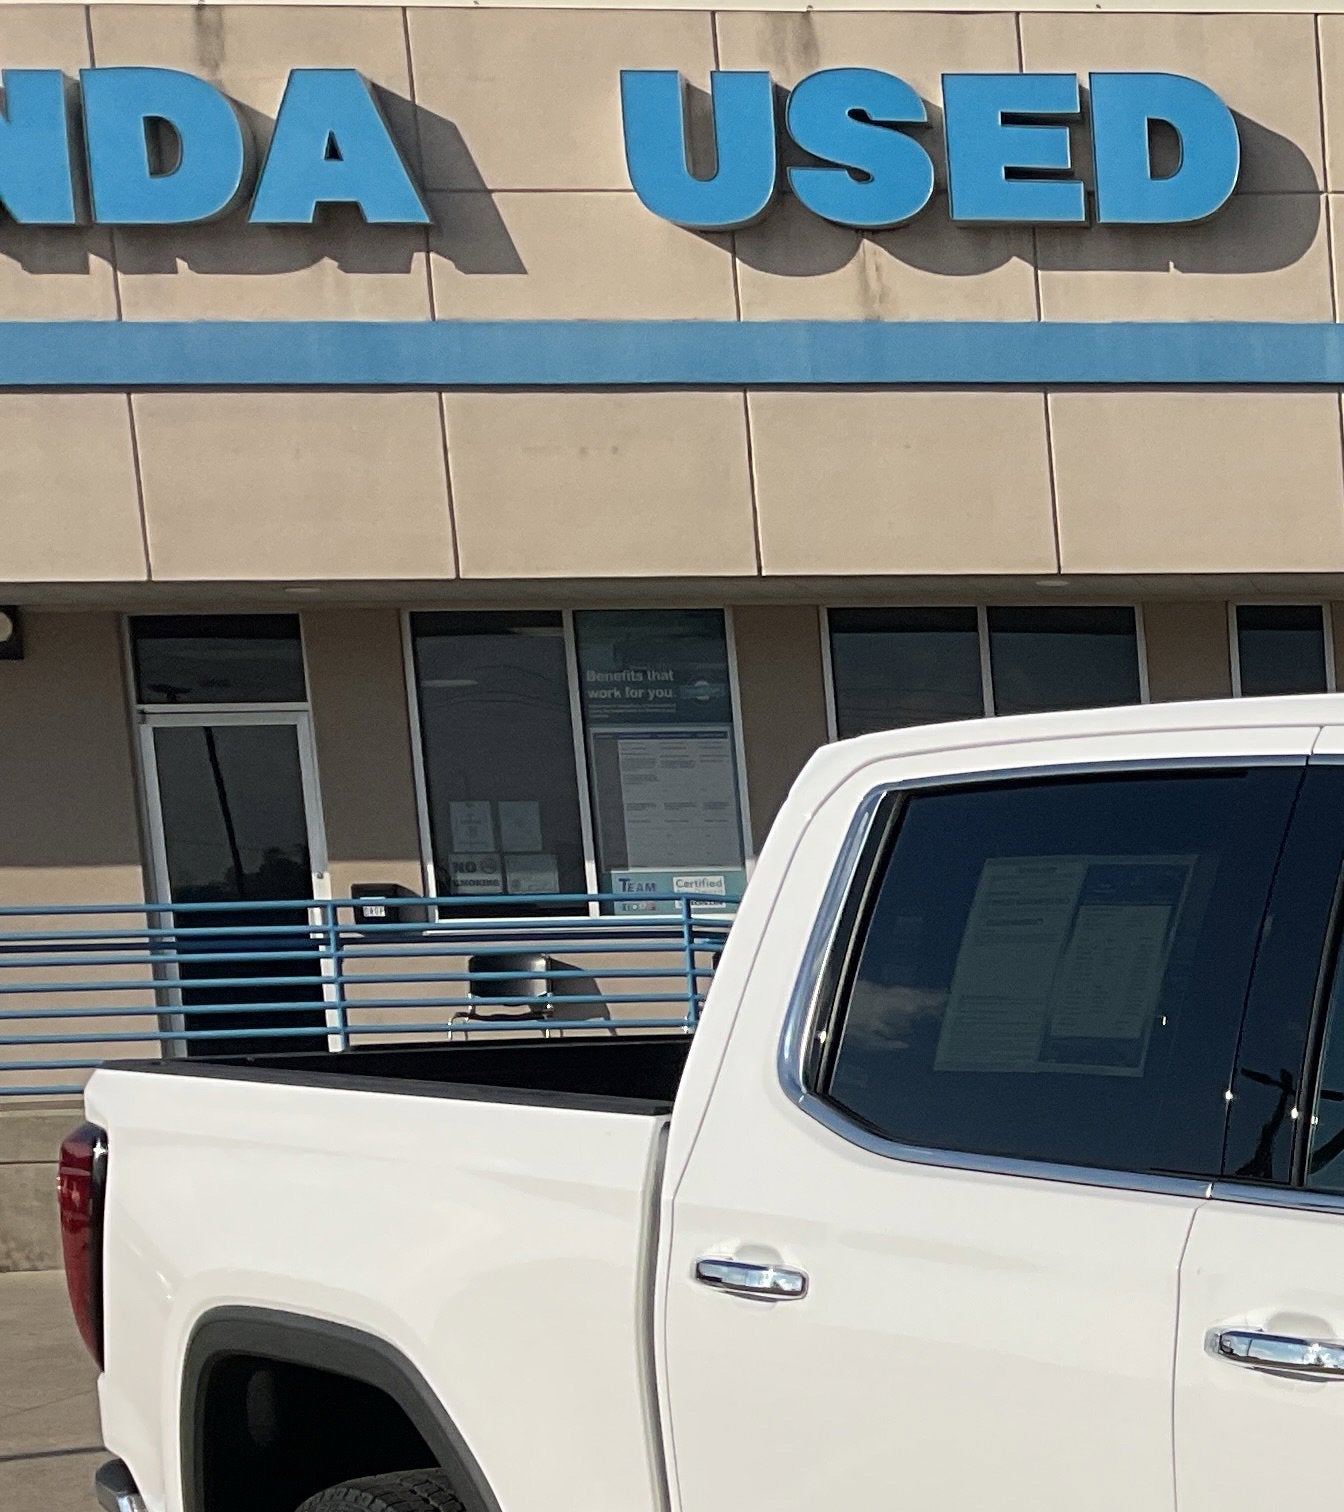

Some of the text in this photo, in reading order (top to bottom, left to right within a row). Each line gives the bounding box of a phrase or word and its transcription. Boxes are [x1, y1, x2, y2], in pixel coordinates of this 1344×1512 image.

[619, 67, 1242, 228] USED
[586, 670, 674, 681] Benefits that
[588, 687, 621, 698] work
[625, 687, 645, 698] for
[452, 861, 477, 873] NO
[675, 878, 723, 889] Certified
